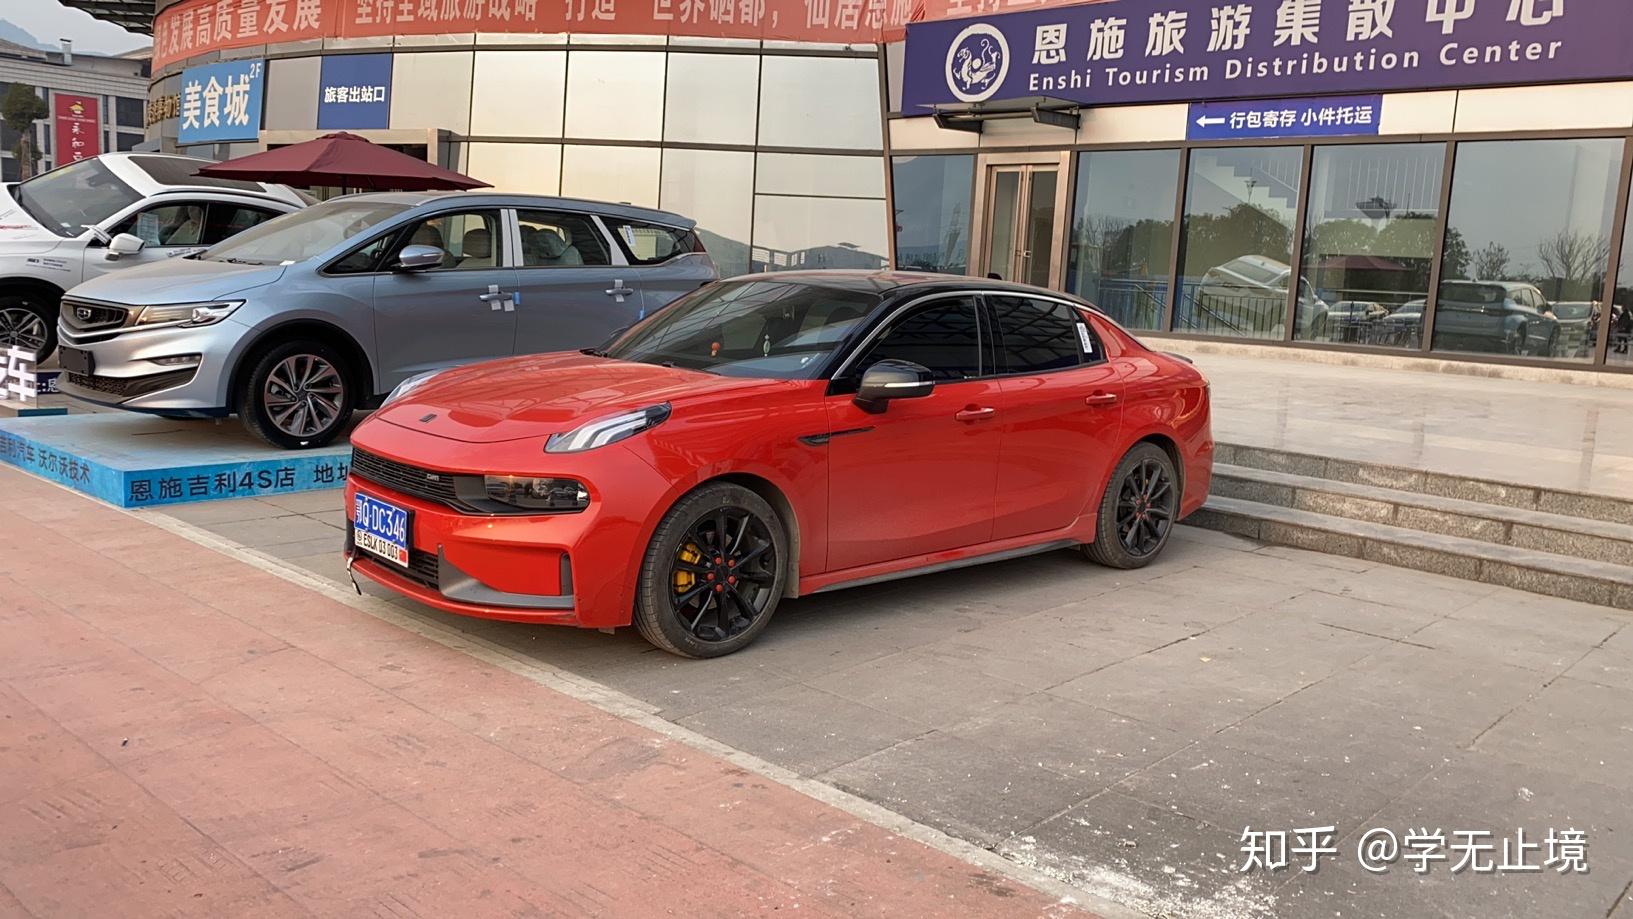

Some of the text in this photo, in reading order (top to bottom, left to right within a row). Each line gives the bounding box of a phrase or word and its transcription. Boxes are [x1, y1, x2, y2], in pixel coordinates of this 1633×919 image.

[1032, 0, 1565, 64] 恩施旅游集散中心
[250, 63, 262, 78] 2F
[1029, 40, 1562, 91] Enshi Tourism Distribution Center
[182, 75, 250, 130] 美食城
[324, 85, 385, 103] 旅客出站口
[1229, 105, 1373, 129] 行包寄存 小件托运
[129, 467, 296, 501] 恩施吉利4S店
